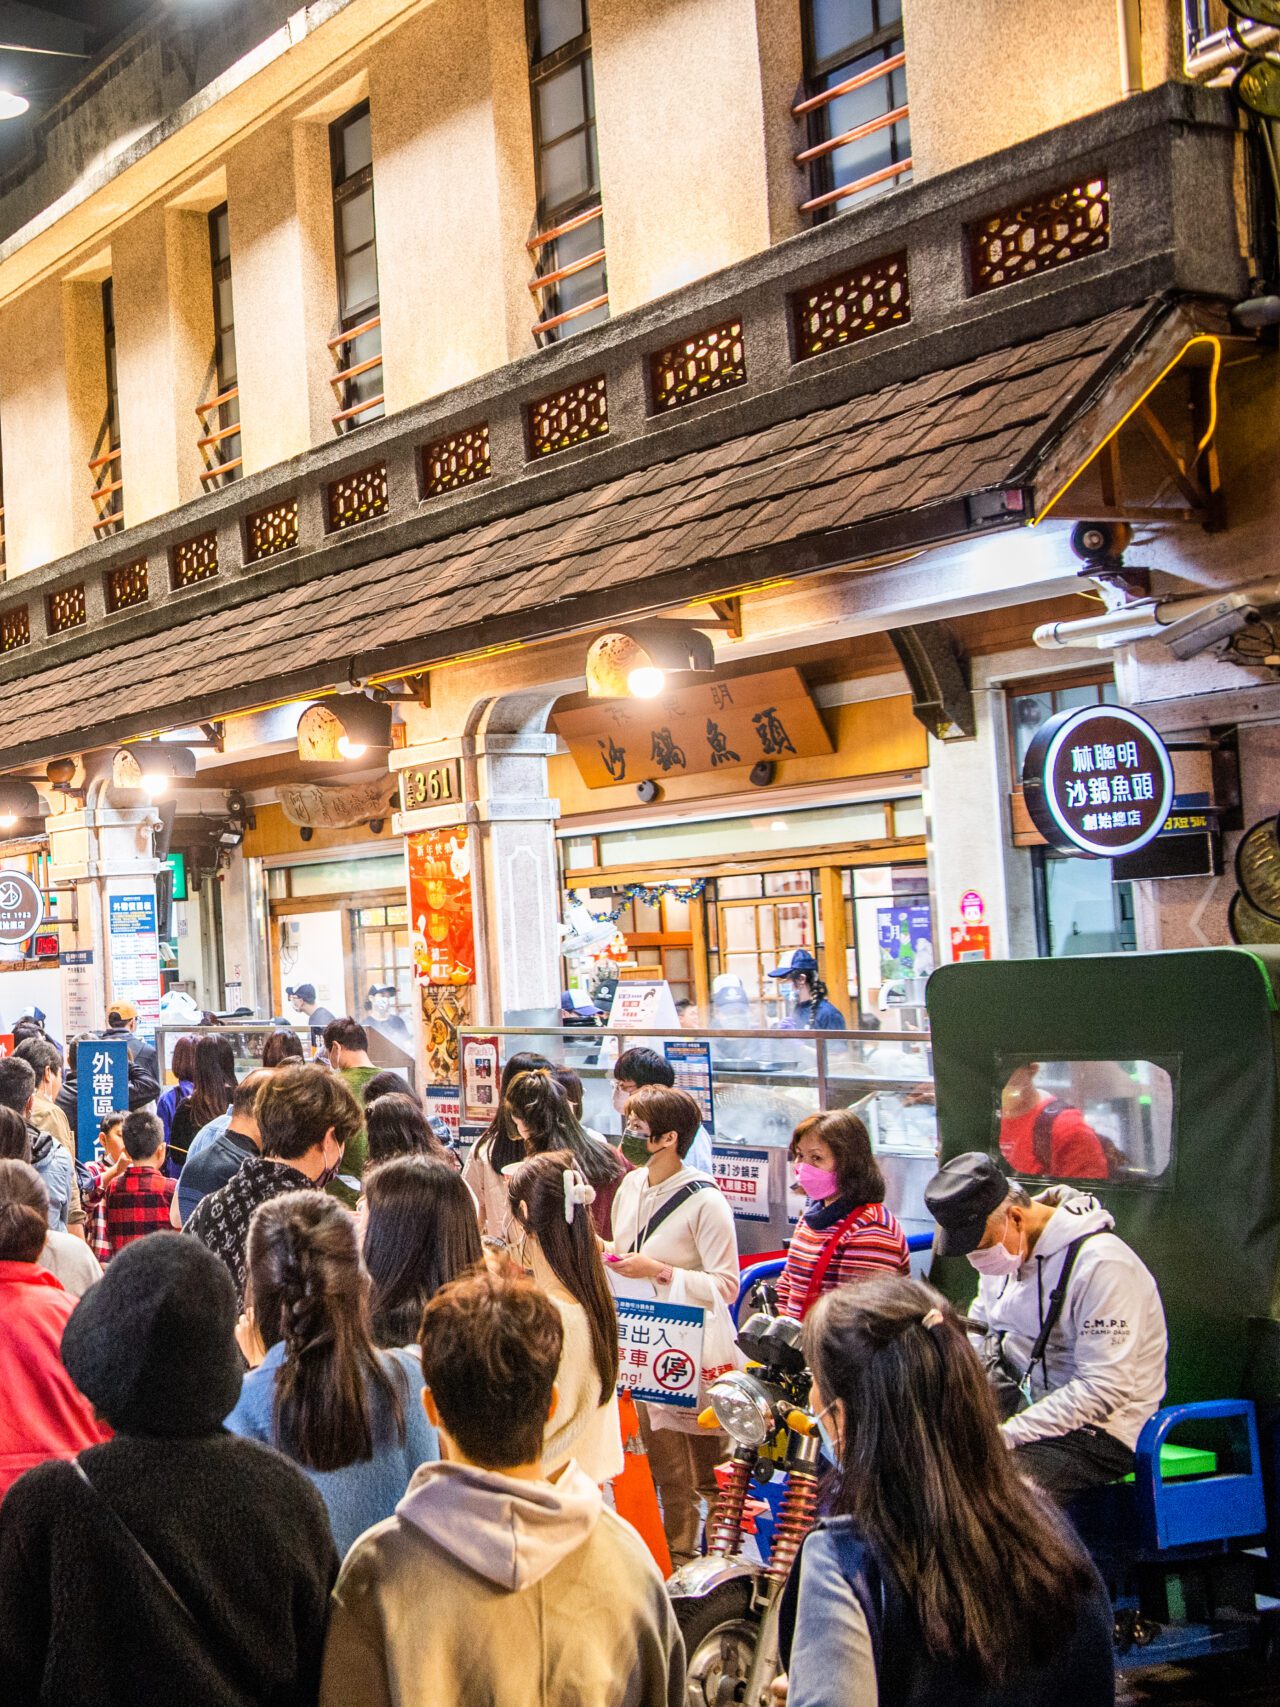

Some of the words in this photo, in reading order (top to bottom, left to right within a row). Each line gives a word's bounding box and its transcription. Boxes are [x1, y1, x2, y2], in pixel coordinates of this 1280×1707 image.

[597, 707, 797, 781] 沙鍋魚頭
[1071, 741, 1138, 773] 林聰明
[415, 768, 452, 803] 361
[1065, 772, 1154, 807] 沙鍋魚頭
[662, 1355, 688, 1383] 停
